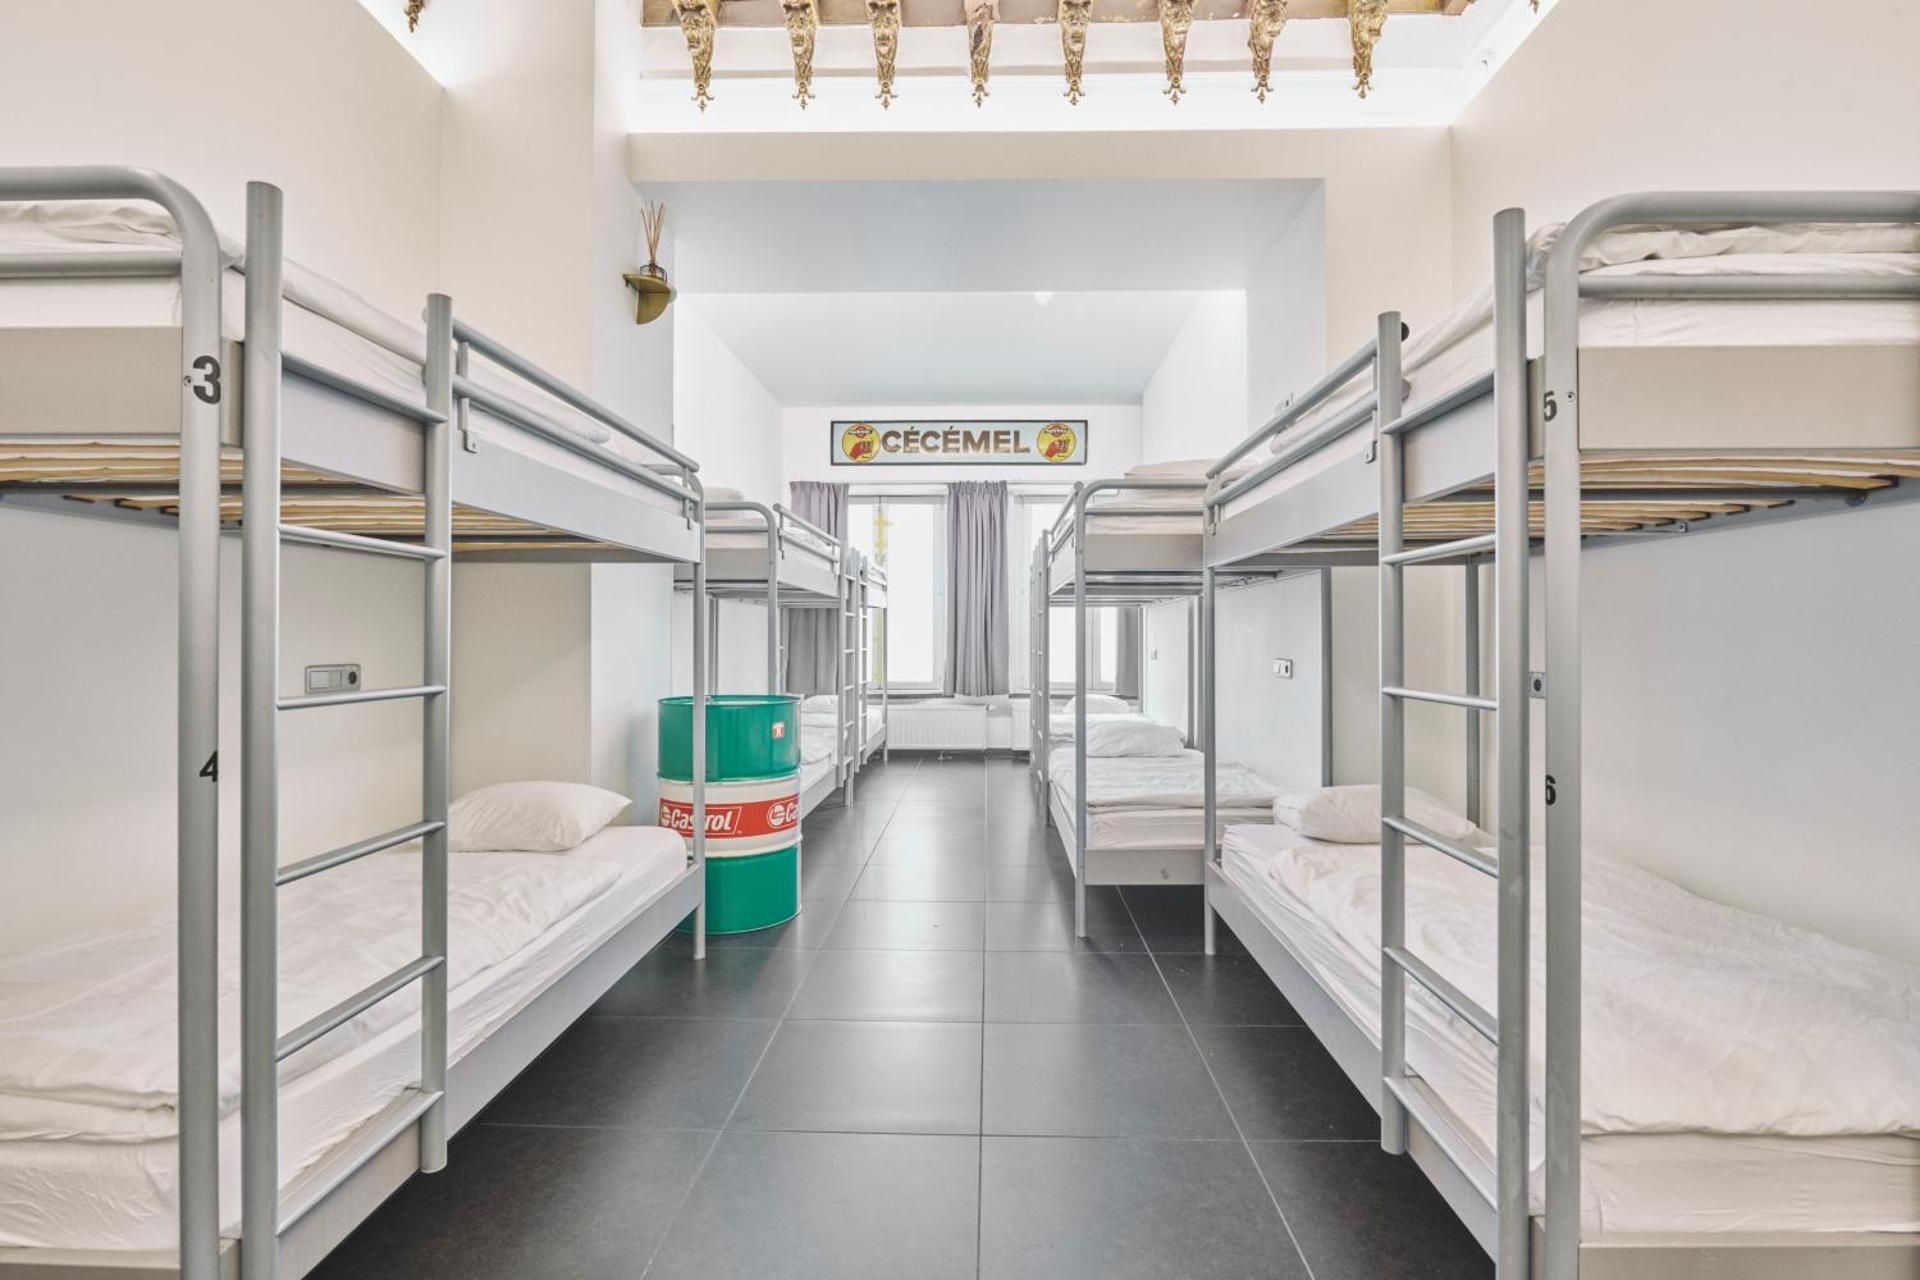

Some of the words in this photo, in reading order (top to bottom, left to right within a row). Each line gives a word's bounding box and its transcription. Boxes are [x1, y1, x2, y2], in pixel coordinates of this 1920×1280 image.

[193, 355, 221, 404] 3
[1544, 390, 1557, 422] 5
[881, 425, 1031, 454] CÉCÉMEL
[199, 750, 218, 782] 4
[1545, 774, 1556, 805] 6
[671, 808, 732, 831] Casrol
